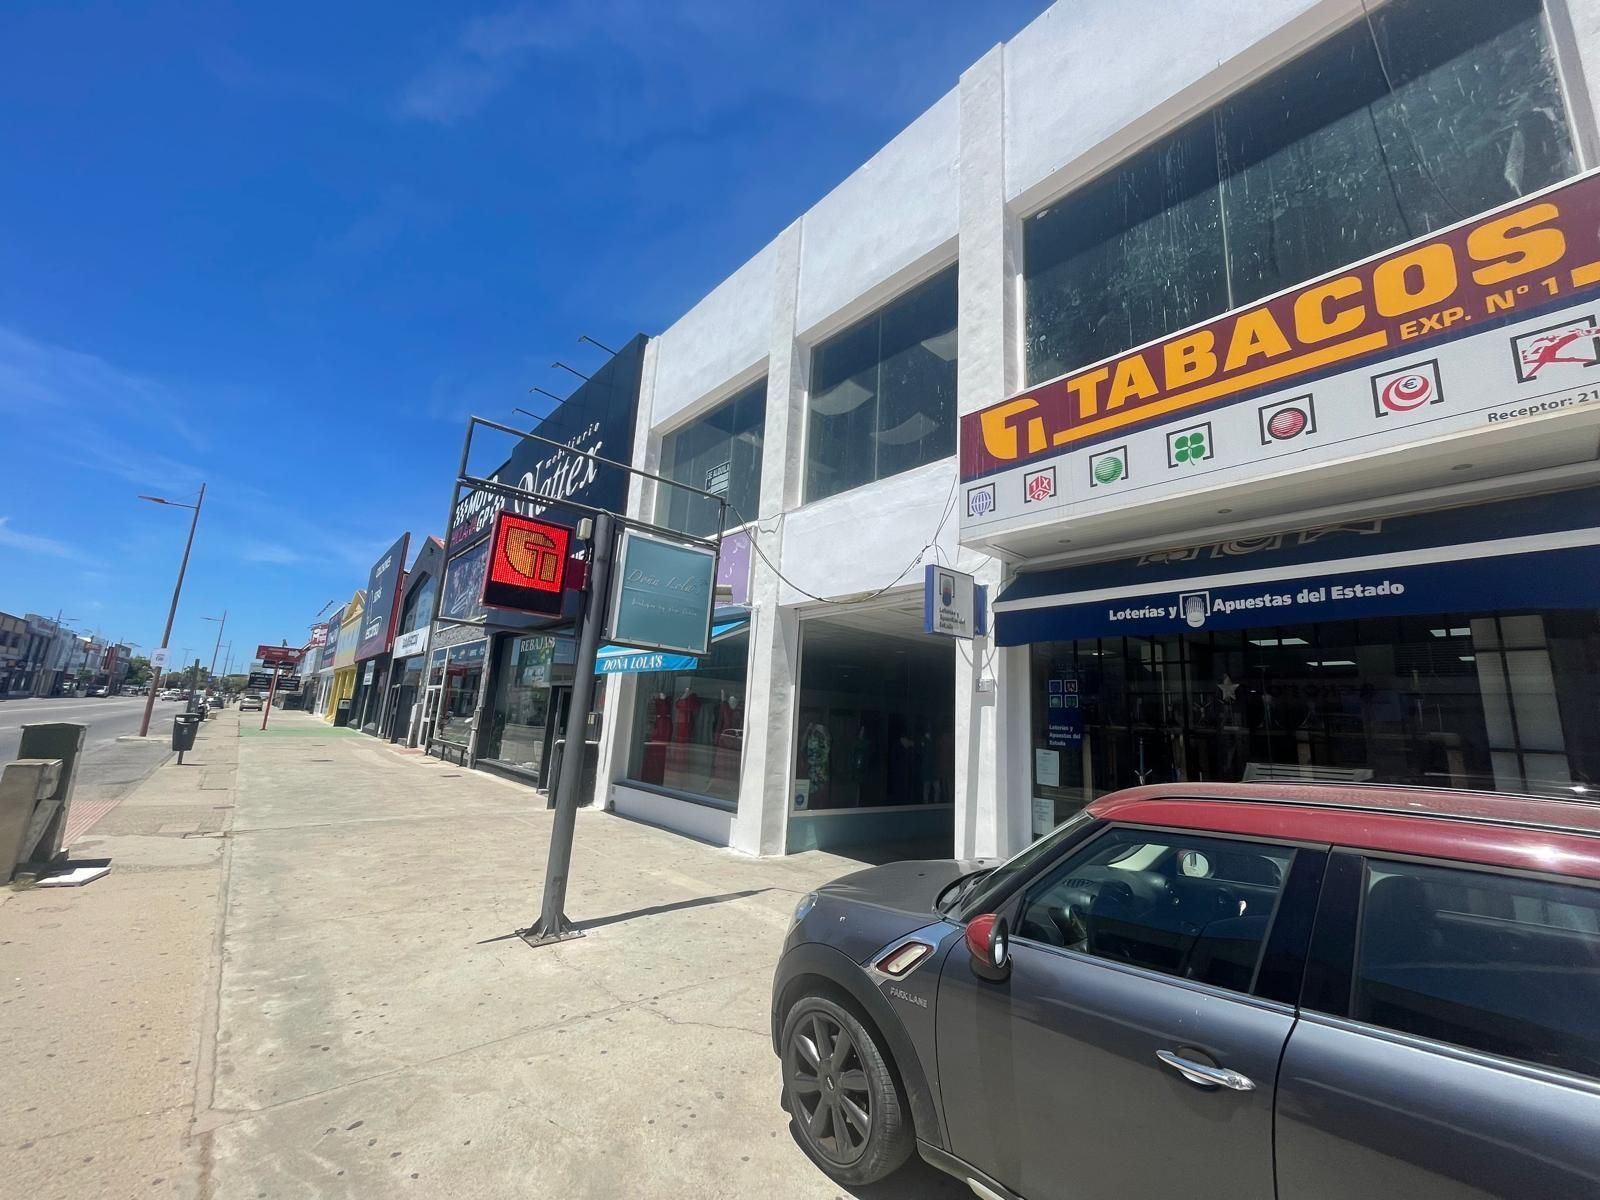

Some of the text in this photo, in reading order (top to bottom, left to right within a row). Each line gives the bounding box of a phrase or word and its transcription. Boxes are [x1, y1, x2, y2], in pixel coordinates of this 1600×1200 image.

[1067, 203, 1566, 412] TABACOS
[1400, 307, 1471, 340] EXP.
[1542, 276, 1559, 295] 1
[1487, 397, 1573, 423] Receptor:
[1109, 580, 1405, 621] Loterías y Apuestas del Estado
[603, 655, 663, 671] DOÑA LOLA'S
[890, 986, 928, 1008] PARK LANE
